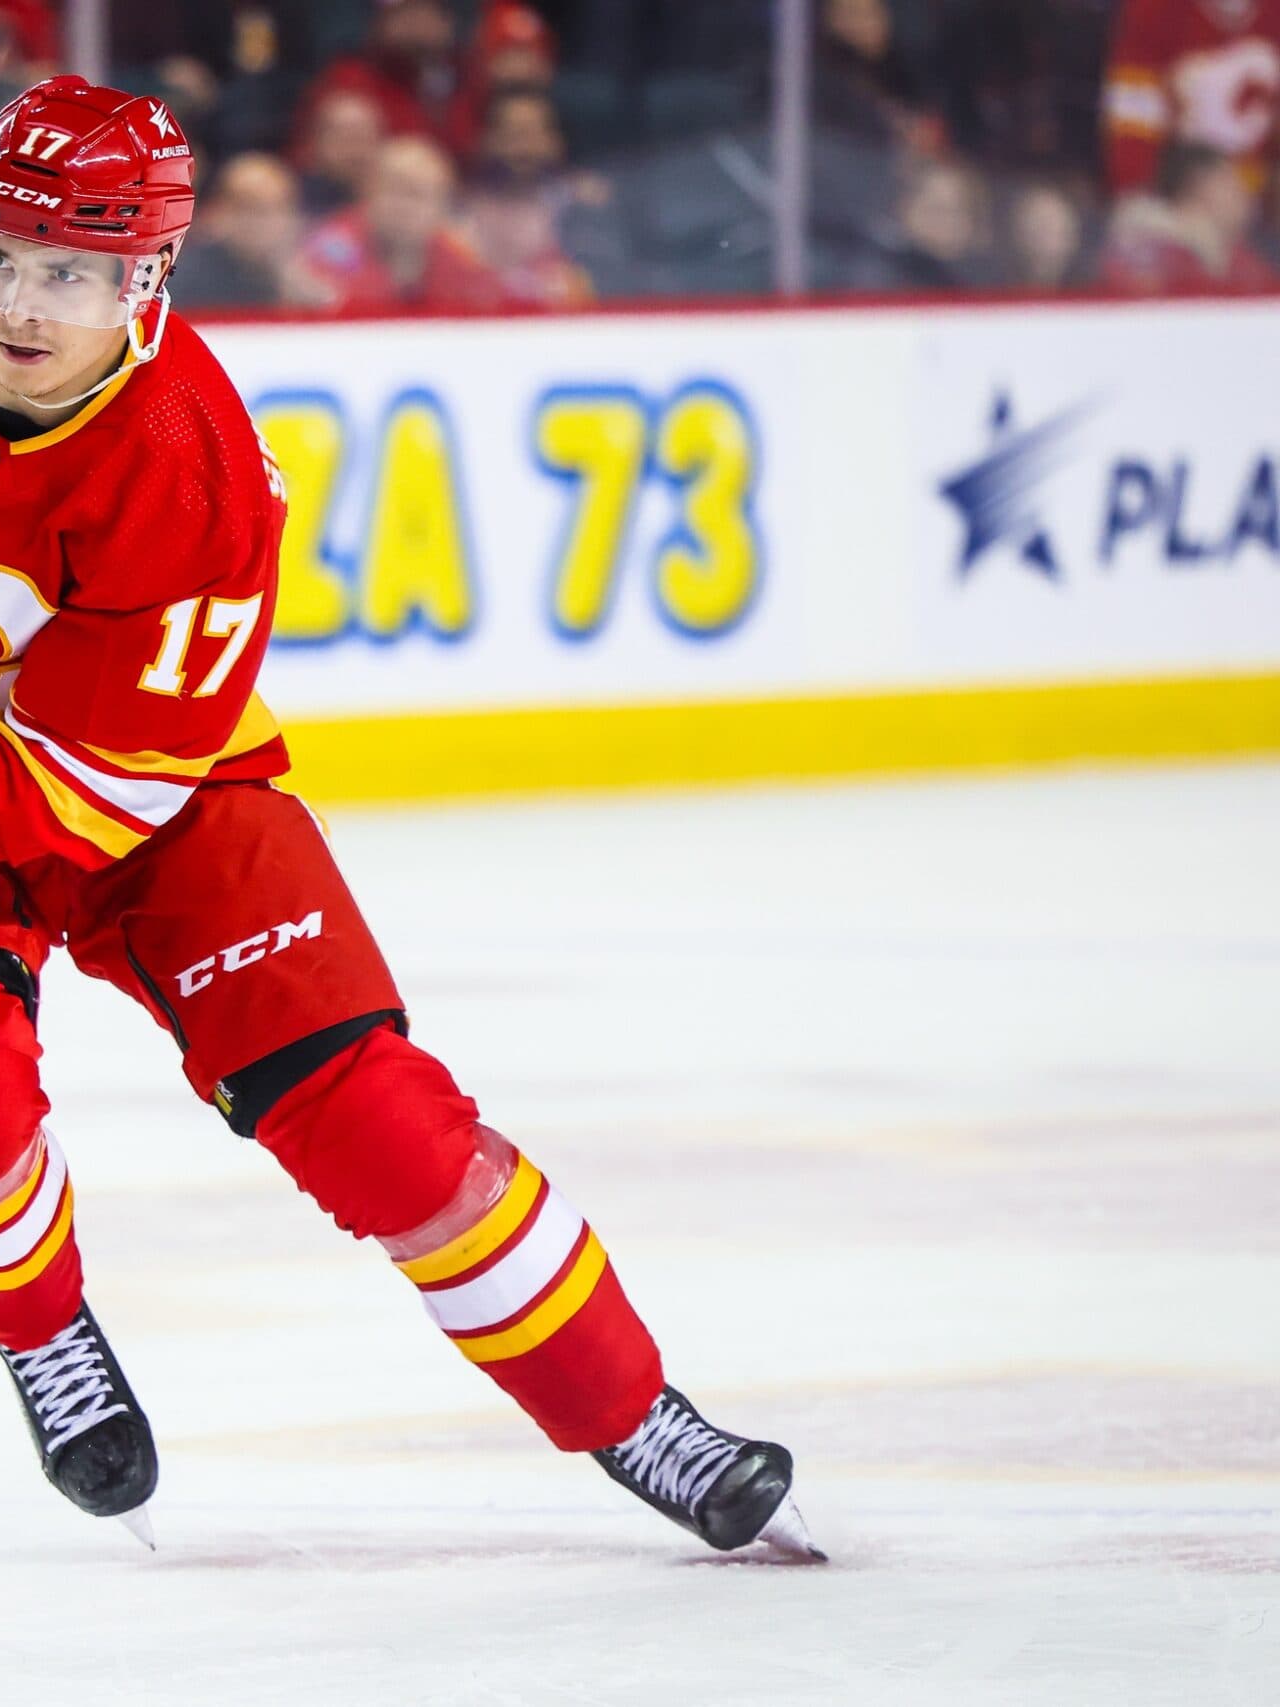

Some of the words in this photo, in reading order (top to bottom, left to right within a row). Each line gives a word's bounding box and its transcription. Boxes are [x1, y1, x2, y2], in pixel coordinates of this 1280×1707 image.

[17, 127, 73, 160] 17
[532, 376, 765, 640] 73
[136, 590, 264, 698] 17
[174, 911, 323, 998] CCM
